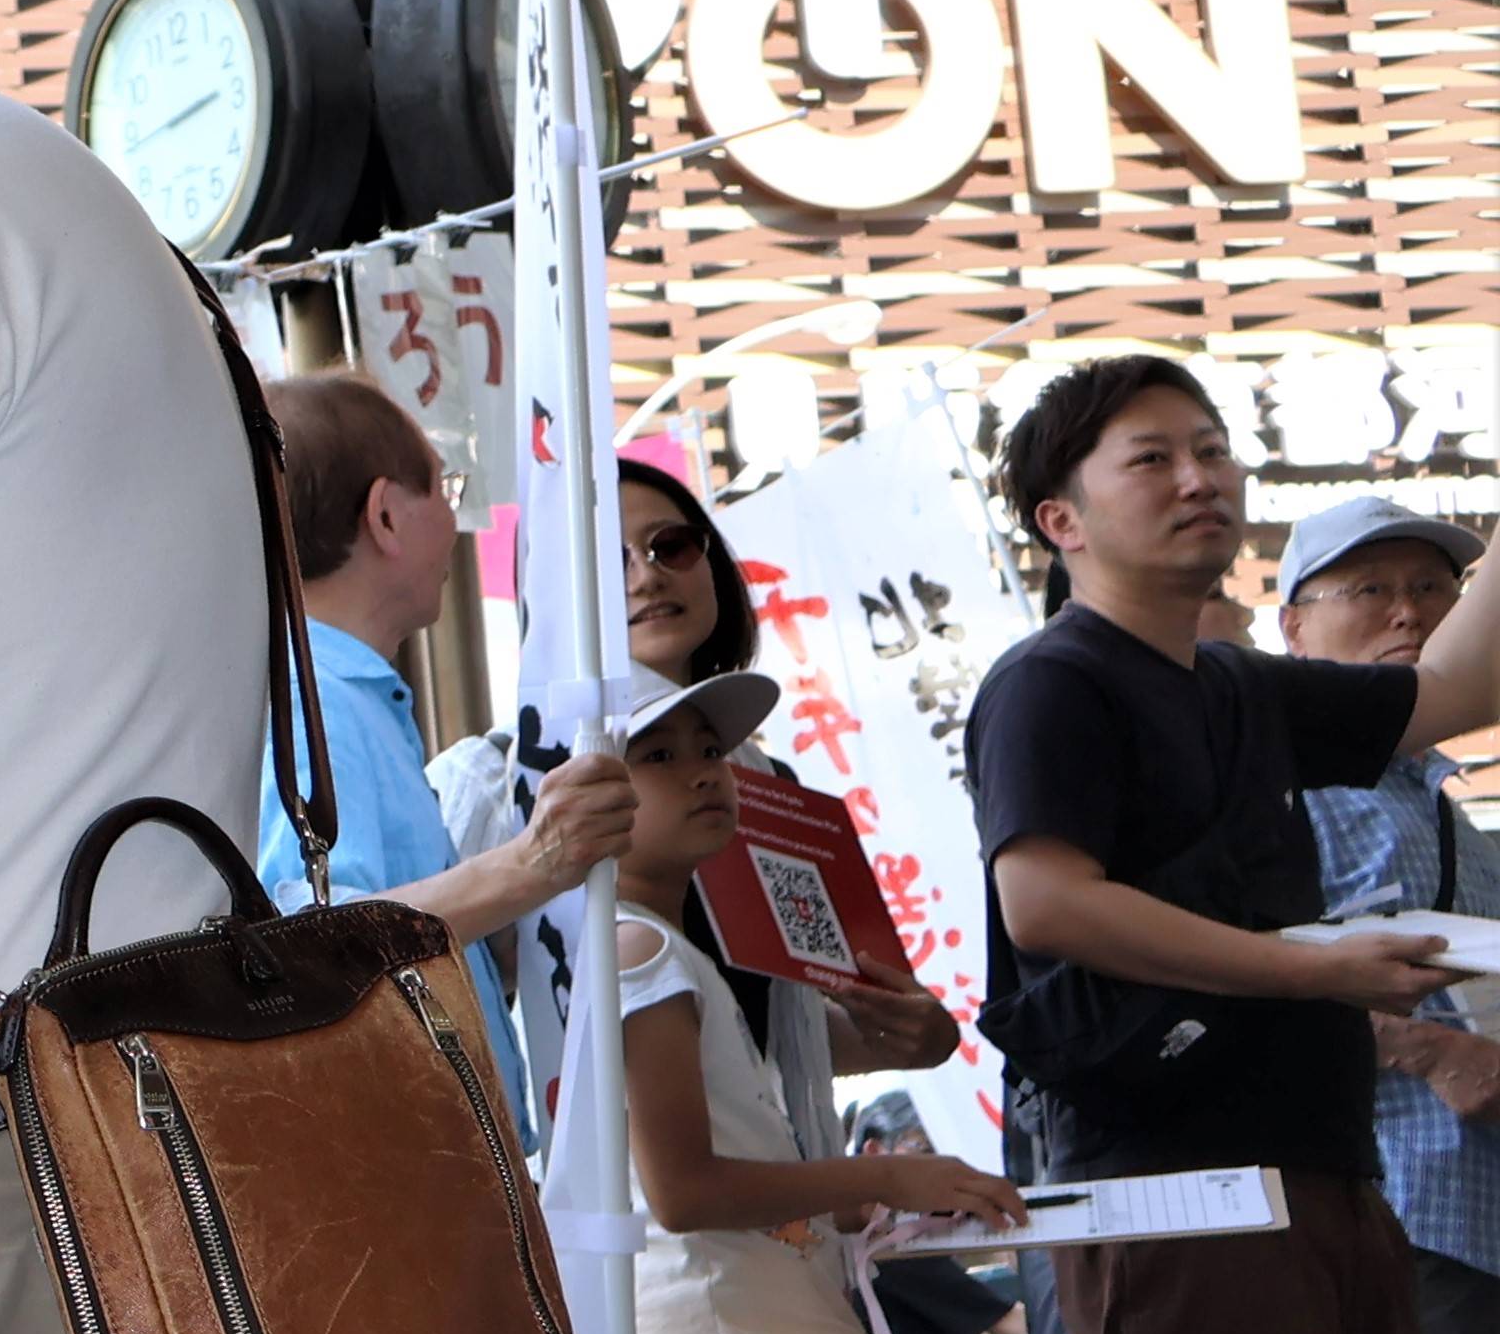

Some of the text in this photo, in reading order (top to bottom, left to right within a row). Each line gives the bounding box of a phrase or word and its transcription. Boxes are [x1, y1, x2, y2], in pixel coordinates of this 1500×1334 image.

[167, 11, 188, 46] 12
[200, 12, 210, 44] 1
[145, 33, 164, 67] 11
[219, 35, 234, 69] 2
[230, 76, 245, 110] 3
[227, 127, 241, 155] 4
[209, 167, 224, 201] 5
[160, 186, 172, 220] 7
[184, 186, 200, 220] 6
[380, 273, 504, 407] ろう
